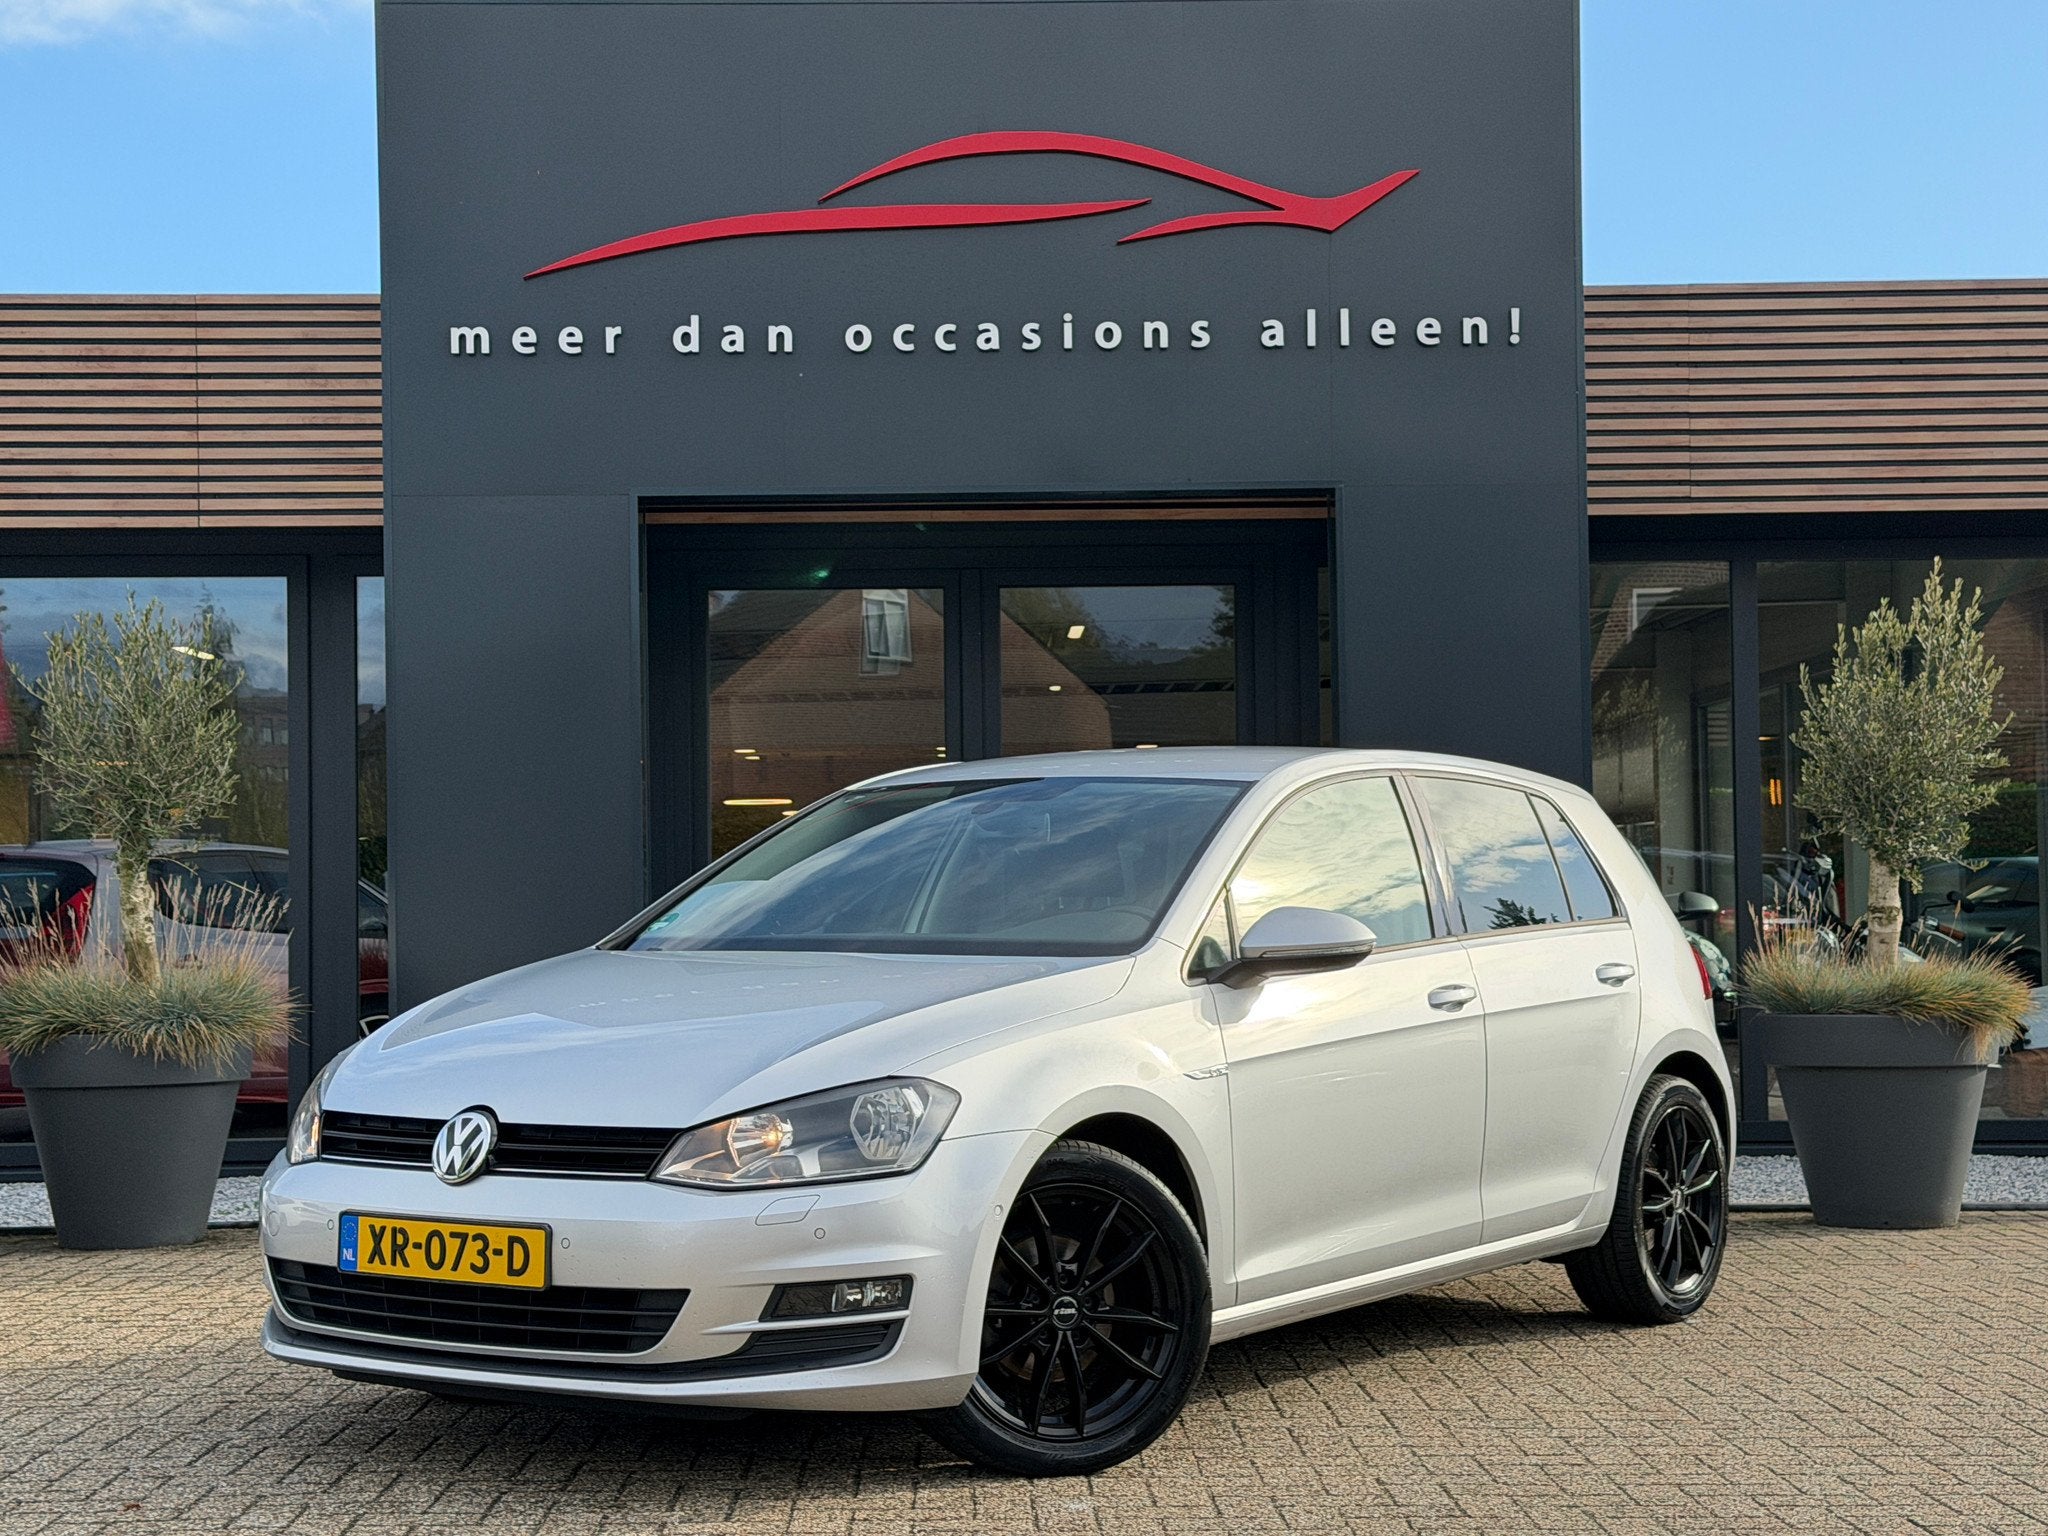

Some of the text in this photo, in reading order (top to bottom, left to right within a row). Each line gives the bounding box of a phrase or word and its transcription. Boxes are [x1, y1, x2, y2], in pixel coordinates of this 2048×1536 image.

[450, 307, 1521, 355] meer dan occasions alleen!
[434, 1112, 490, 1182] VW
[342, 1248, 356, 1262] NL
[366, 1223, 531, 1278] XR-073-D
